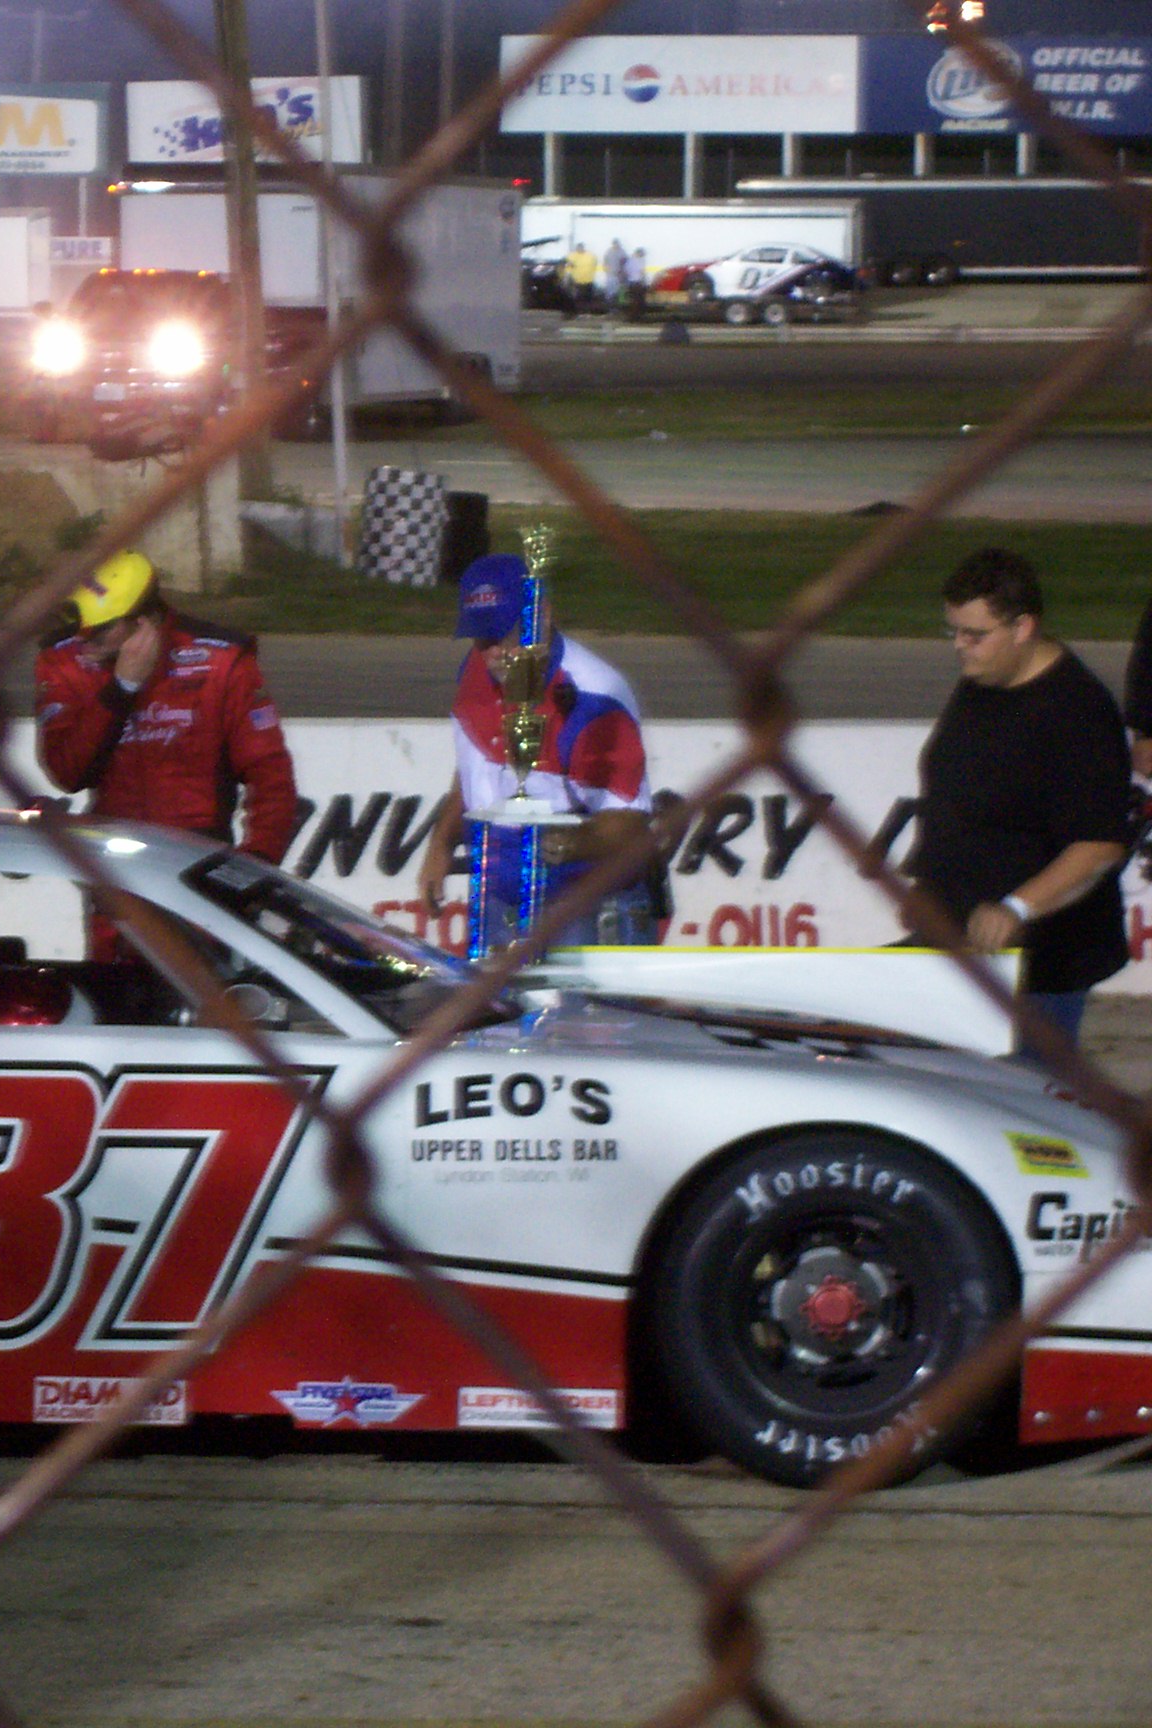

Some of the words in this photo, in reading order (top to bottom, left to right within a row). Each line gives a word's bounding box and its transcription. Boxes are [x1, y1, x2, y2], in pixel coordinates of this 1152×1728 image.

[1032, 47, 1145, 68] OFFICIAL
[1104, 73, 1143, 93] OF
[414, 1072, 614, 1129] LEO'S
[411, 1138, 484, 1162] UPPER
[494, 1138, 563, 1162] DELLS
[572, 1138, 619, 1162] BAR
[35, 1379, 181, 1408] DIAMD
